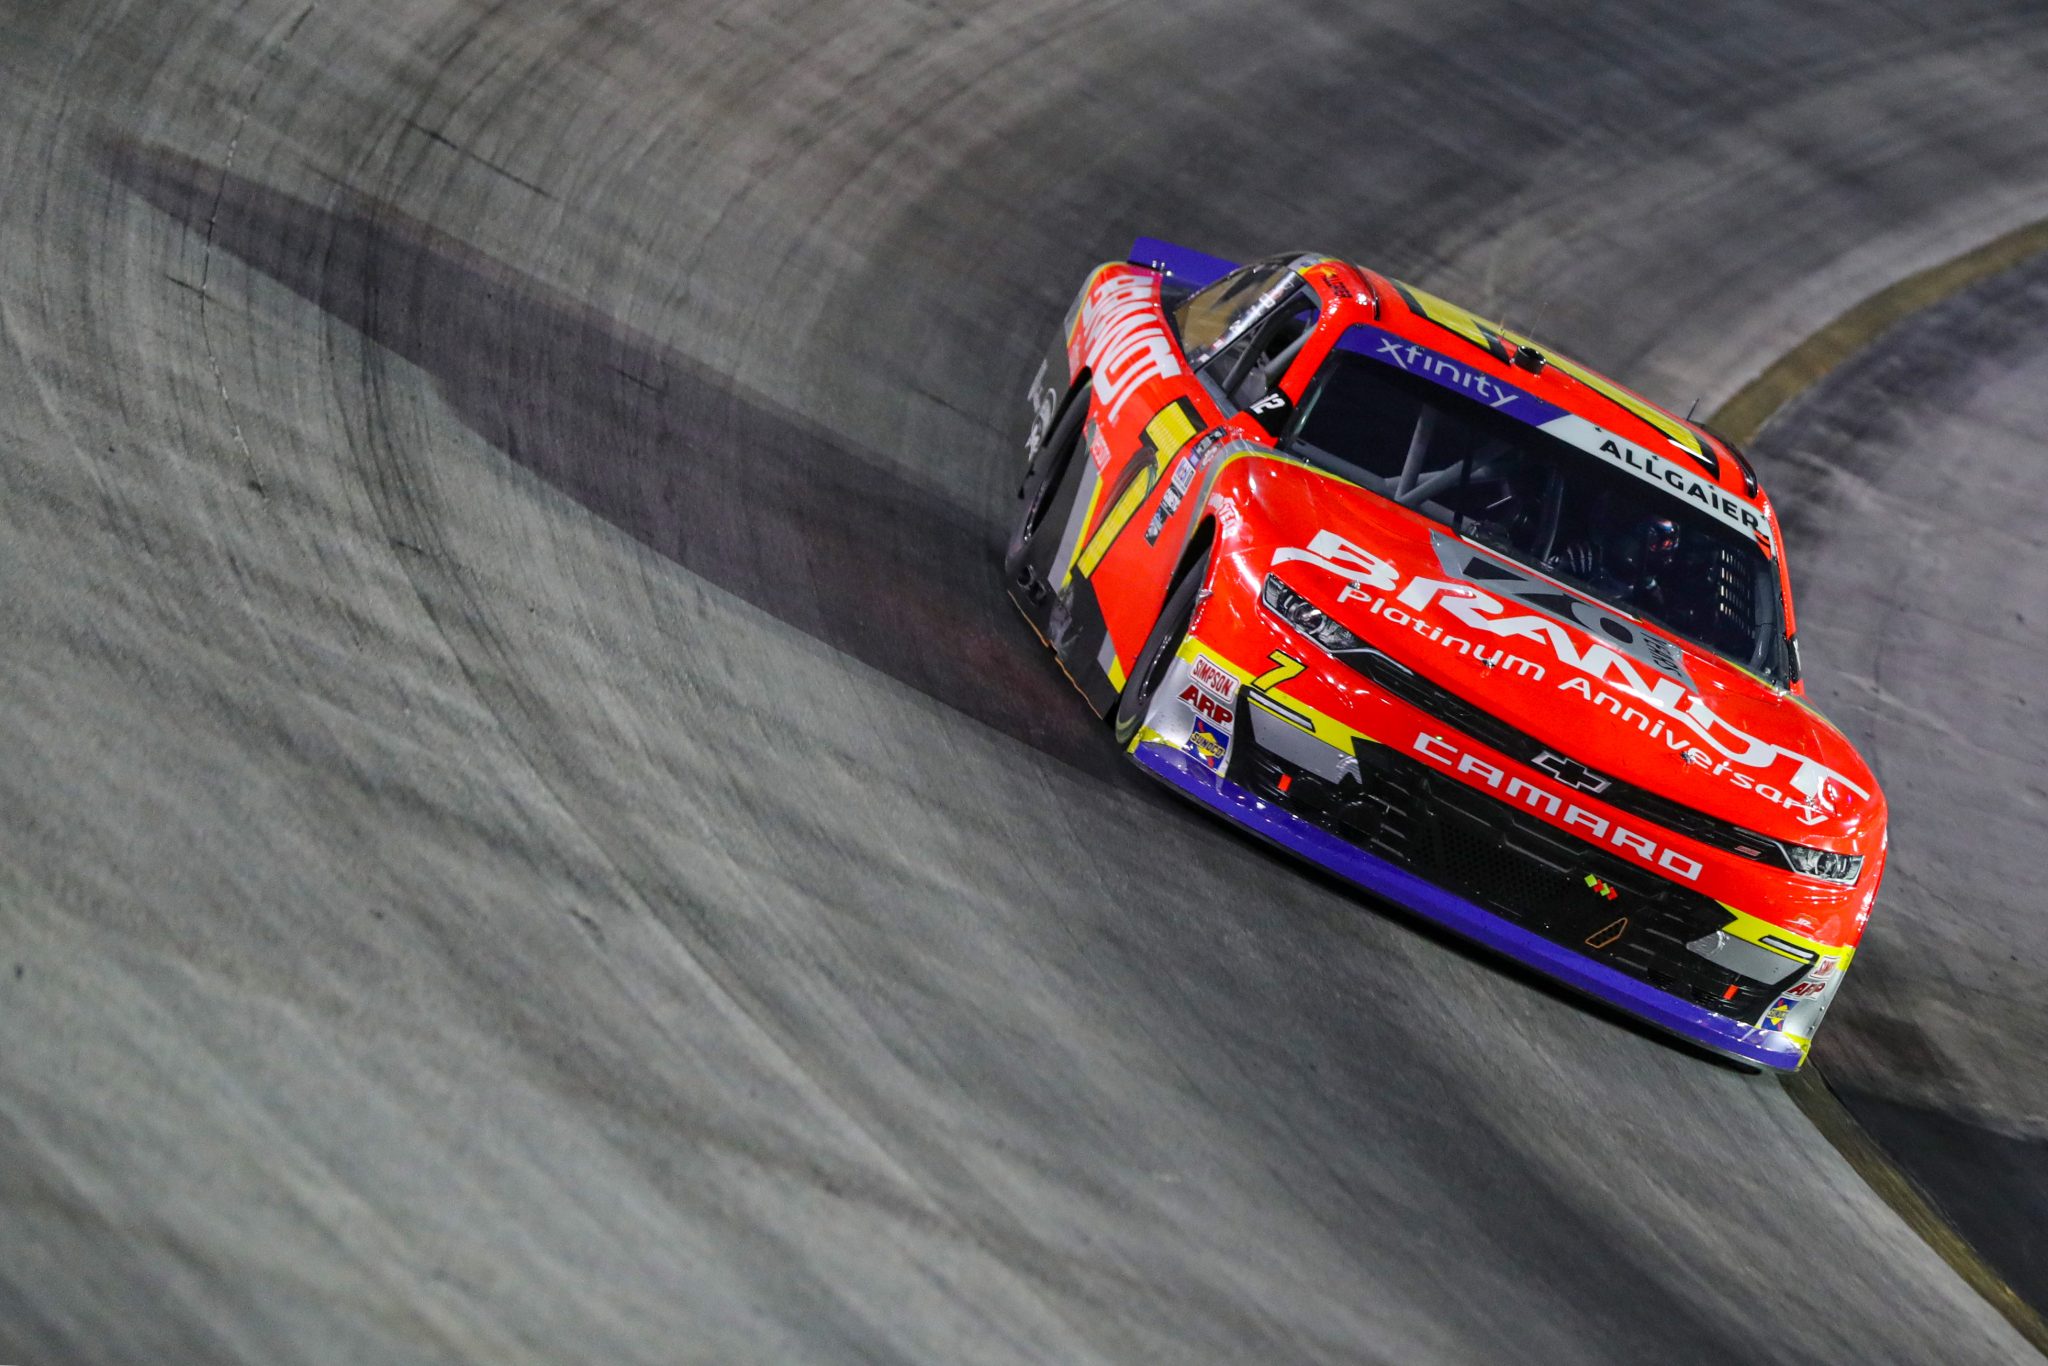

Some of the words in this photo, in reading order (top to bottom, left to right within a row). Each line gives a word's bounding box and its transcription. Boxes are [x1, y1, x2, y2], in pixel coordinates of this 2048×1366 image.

[1376, 337, 1518, 408] xfinity
[1599, 438, 1761, 532] ALLGAIER
[1192, 659, 1236, 698] SIMPSON
[1250, 648, 1309, 693] 7
[1271, 529, 1870, 806] BRANDT
[1178, 683, 1235, 725] ARP
[1336, 584, 1546, 682] Platinum
[1557, 676, 1829, 826] Anniversary
[1191, 731, 1226, 759] SUNOCO
[1412, 731, 1703, 881] CAMARO
